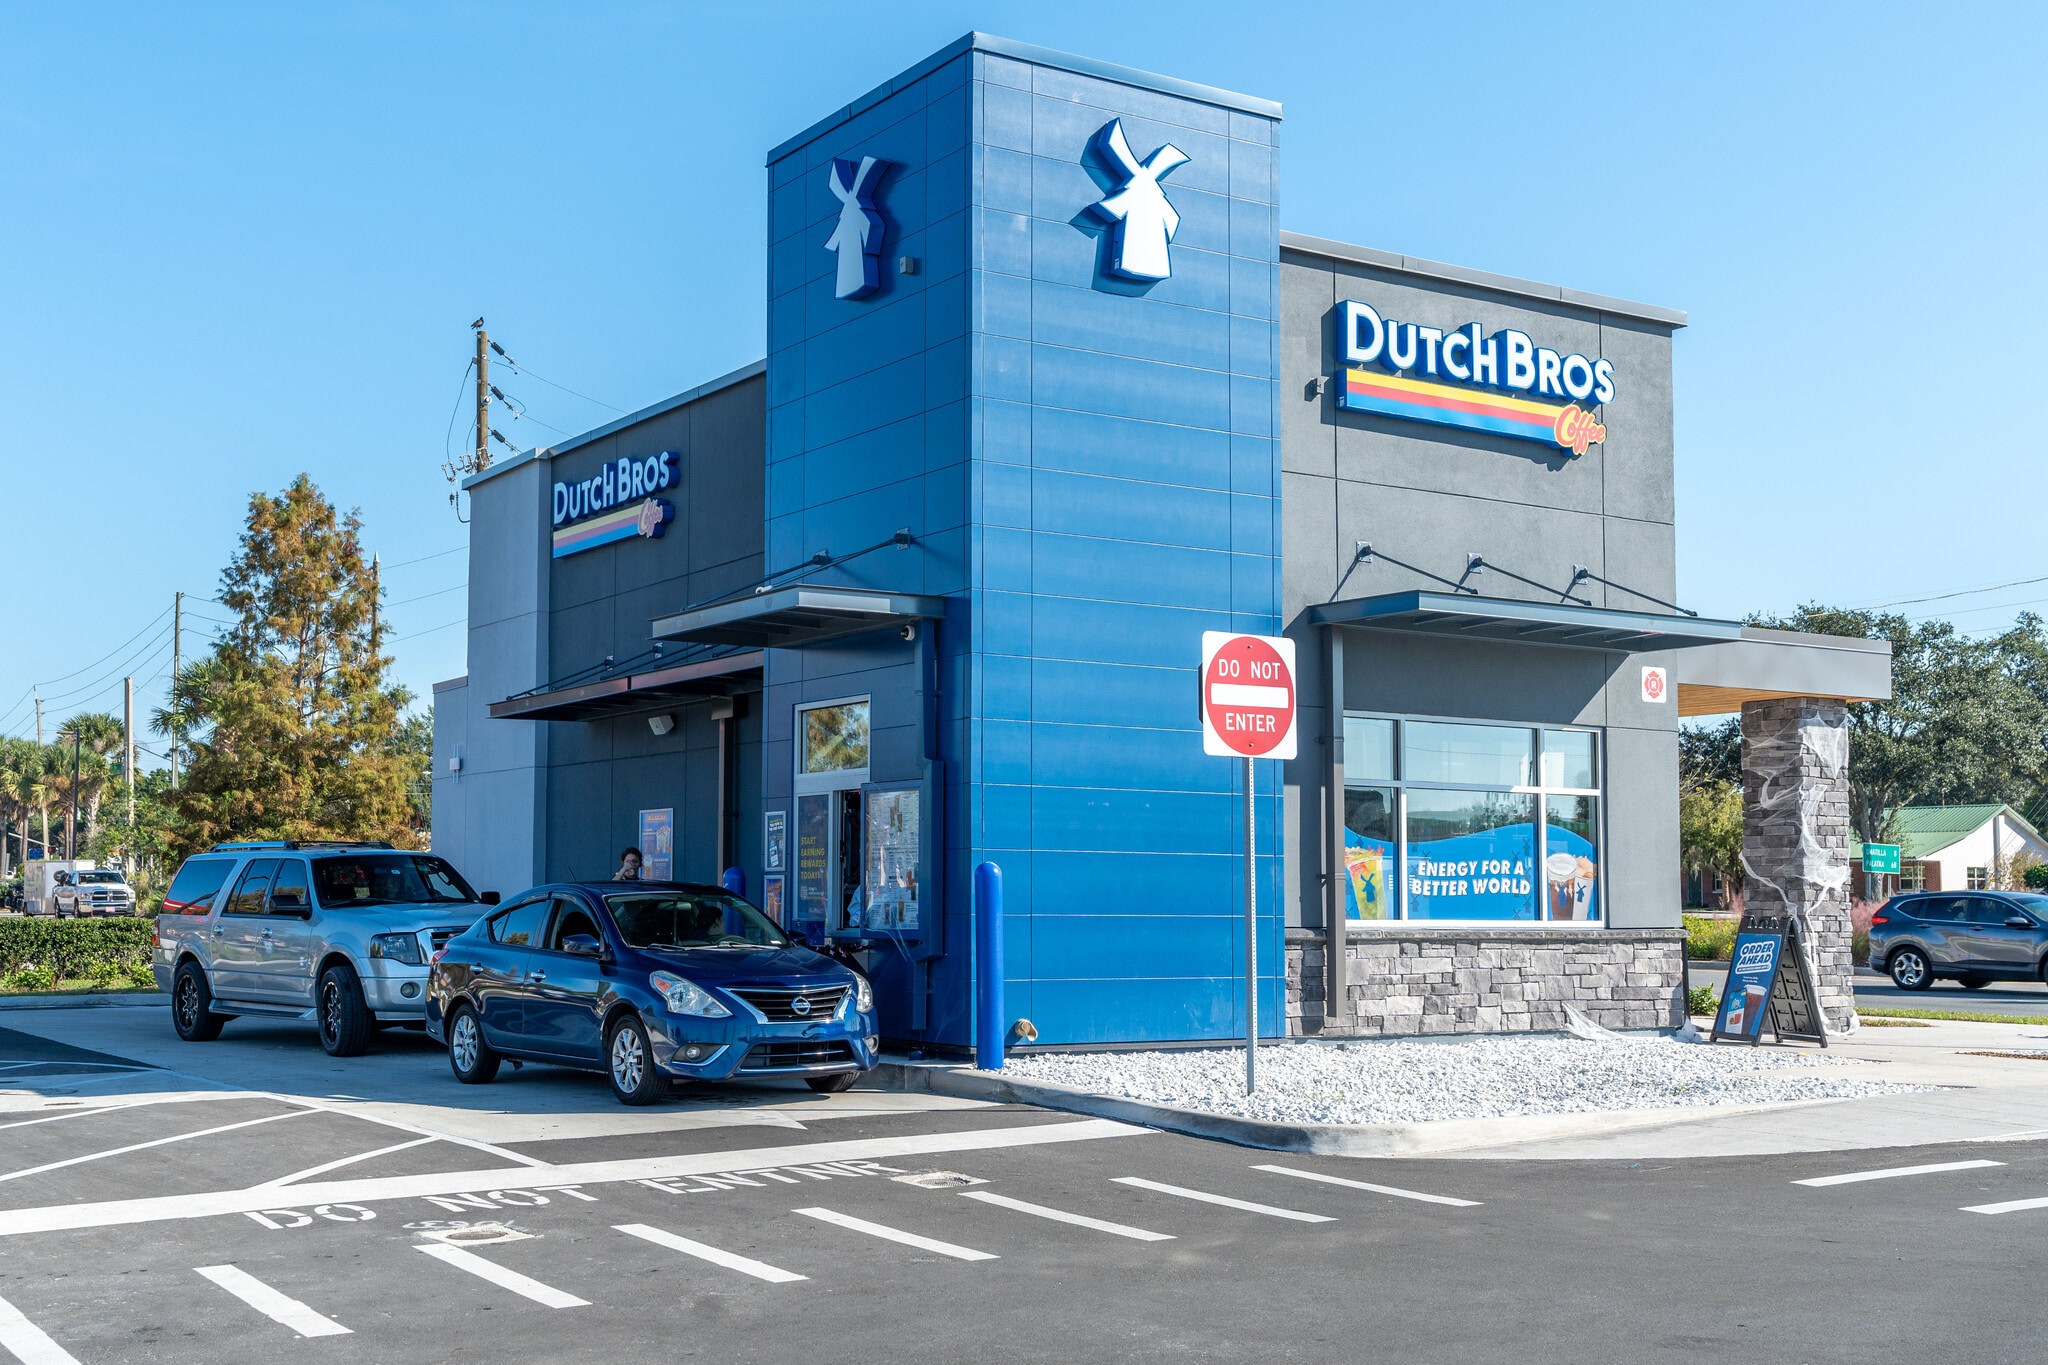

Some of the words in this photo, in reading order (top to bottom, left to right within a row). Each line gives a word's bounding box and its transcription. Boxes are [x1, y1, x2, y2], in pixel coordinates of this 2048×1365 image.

[1505, 328, 1616, 404] BROS
[1556, 404, 1607, 455] Coffee
[617, 451, 671, 503] BROS
[638, 497, 664, 538] Coffee
[1218, 658, 1240, 678] DO
[1250, 660, 1281, 681] NOT
[1225, 712, 1276, 733] ENTER
[800, 836, 816, 846] START
[800, 847, 825, 857] EARNING
[800, 859, 827, 868] REWARDS
[1418, 860, 1478, 877] ENERGY
[1481, 859, 1512, 876] FOR
[1513, 860, 1525, 876] A
[1412, 878, 1469, 897] BETTER
[1473, 877, 1532, 896] WORLD
[1742, 943, 1774, 955] ORDER
[1739, 954, 1772, 965] AHEAD
[243, 1203, 377, 1231] DO
[420, 1184, 601, 1213] NOT
